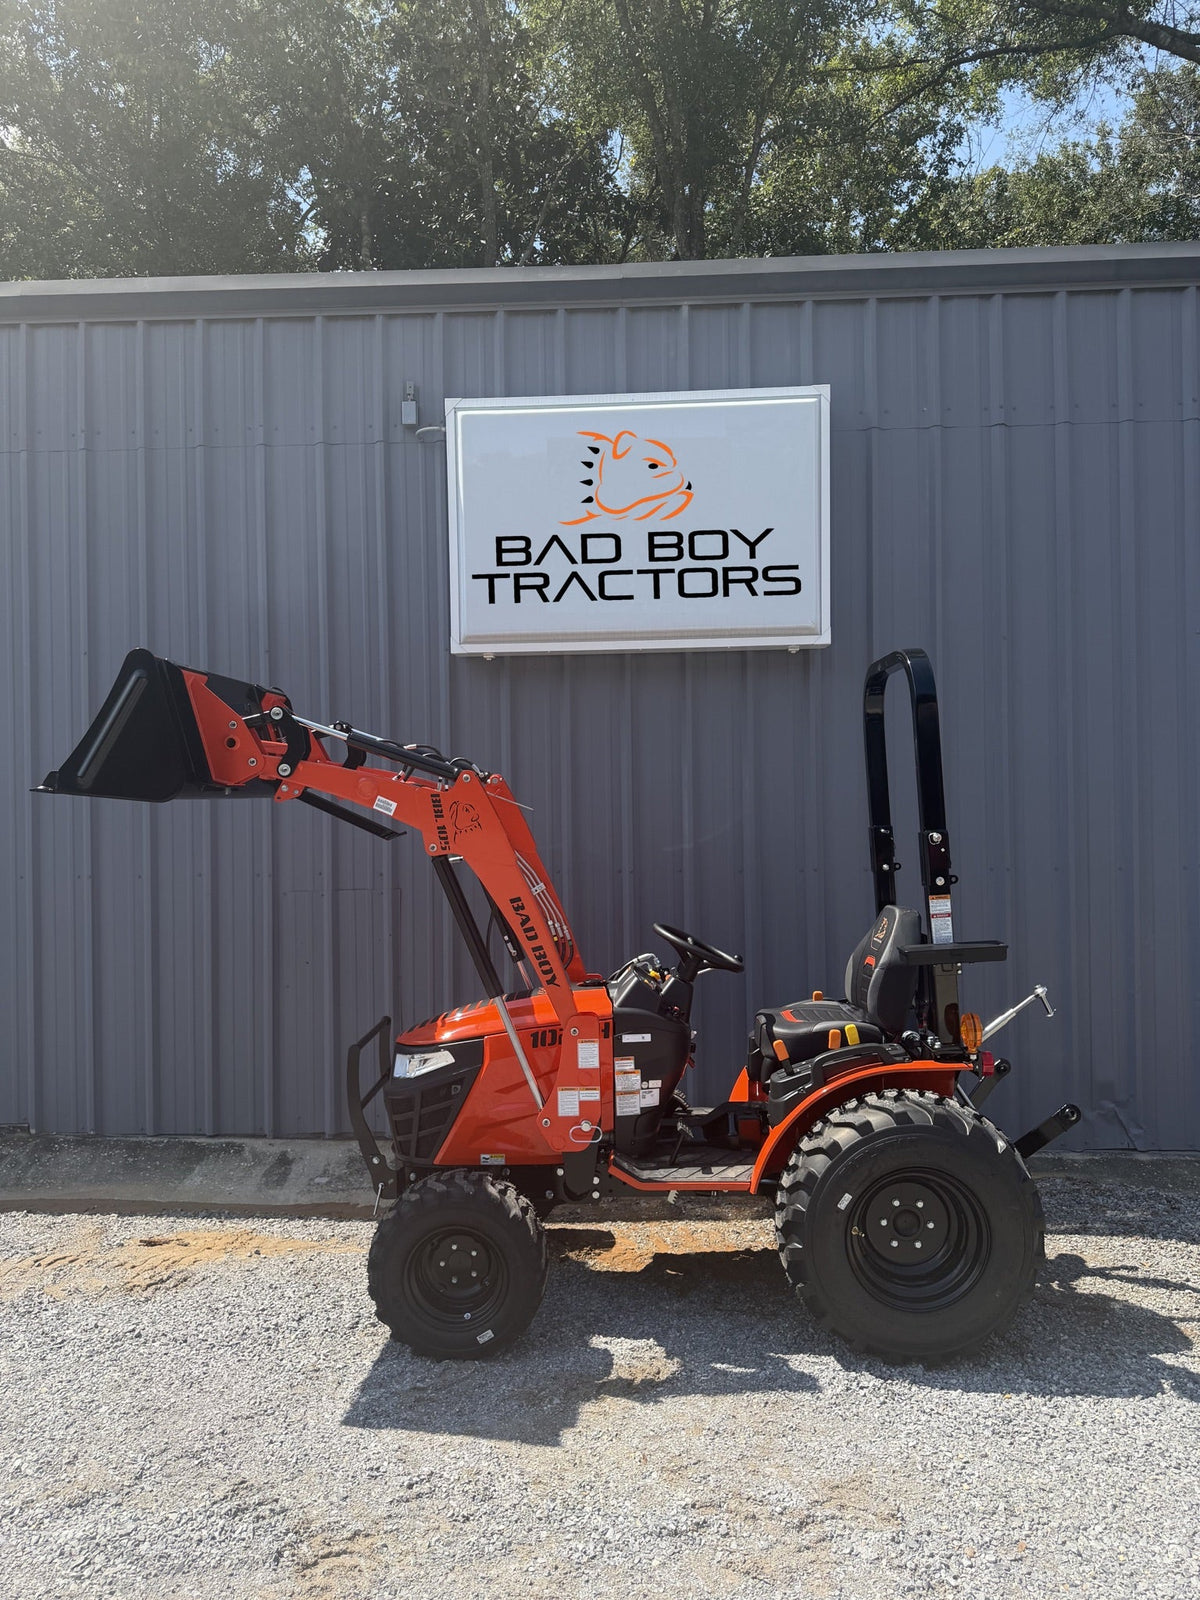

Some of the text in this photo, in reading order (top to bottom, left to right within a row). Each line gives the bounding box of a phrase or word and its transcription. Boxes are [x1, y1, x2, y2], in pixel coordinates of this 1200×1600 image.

[495, 528, 775, 567] BAD BOY
[471, 564, 802, 604] TRACTORS
[509, 896, 561, 988] BAD BOY
